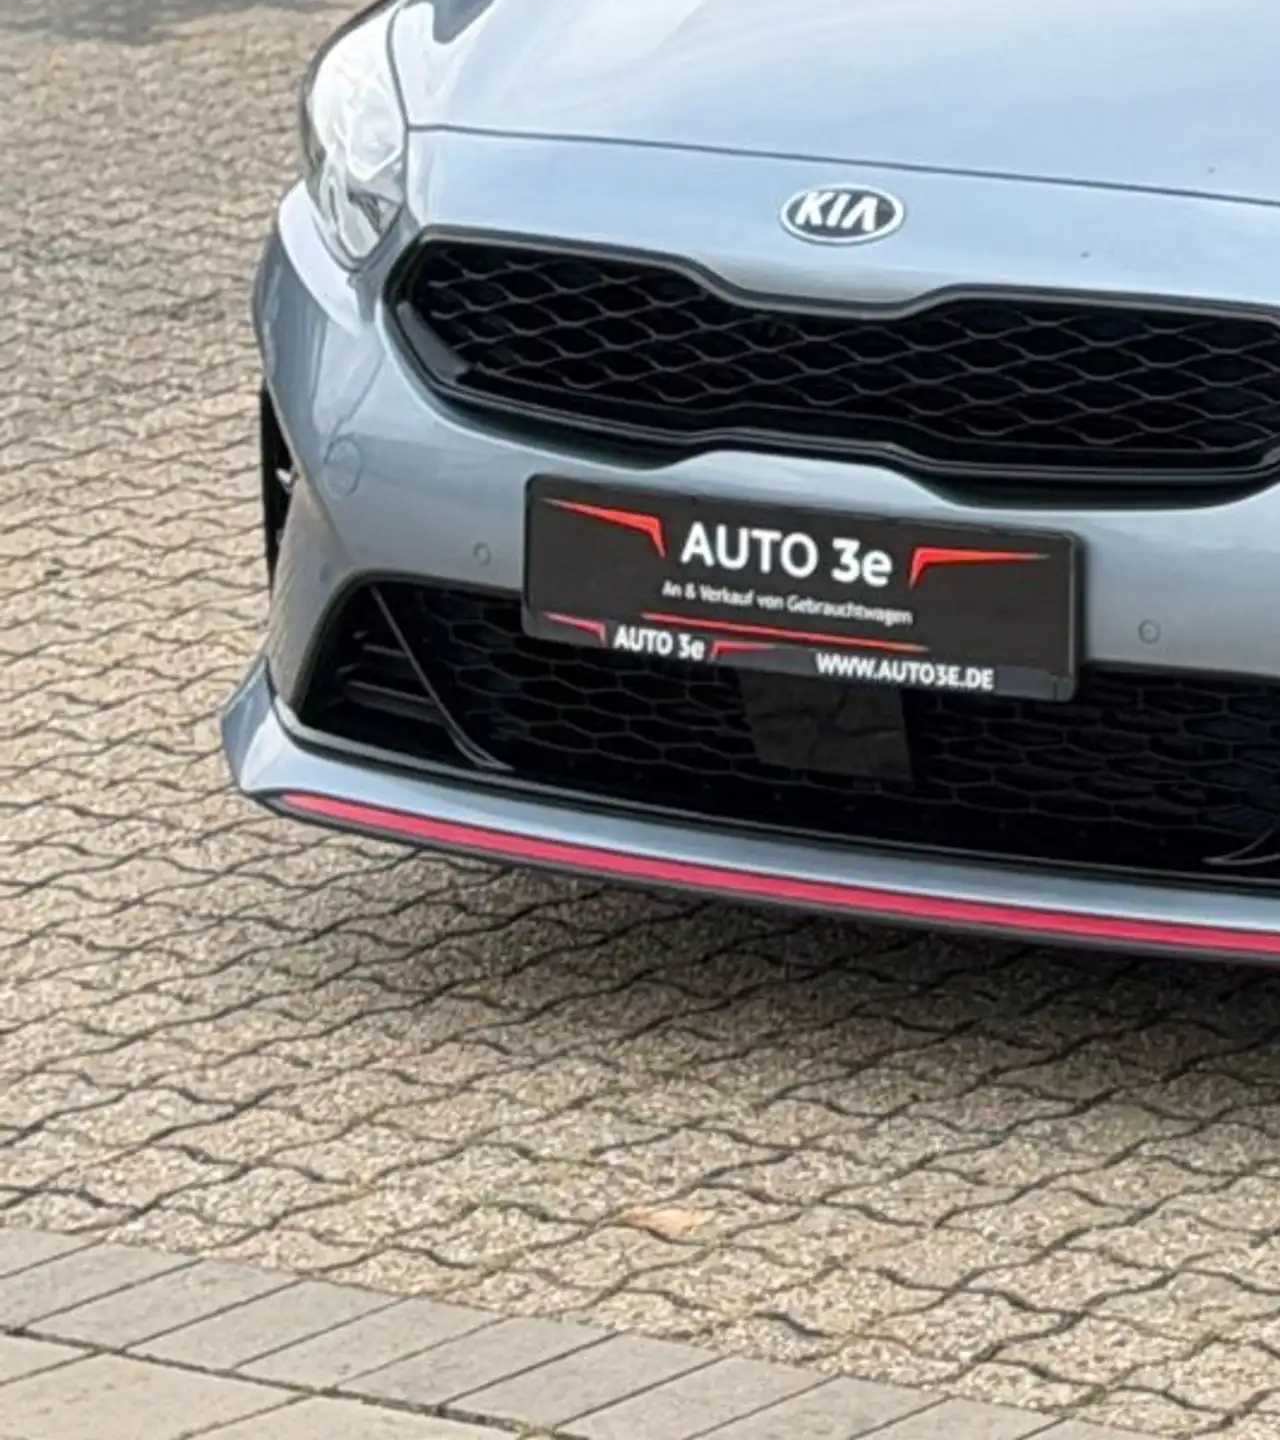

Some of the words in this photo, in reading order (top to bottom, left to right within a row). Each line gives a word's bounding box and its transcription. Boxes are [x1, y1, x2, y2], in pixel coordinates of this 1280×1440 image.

[795, 192, 878, 232] KIA
[681, 520, 818, 579] AUTO
[831, 537, 893, 588] 3e
[662, 579, 682, 597] An
[684, 582, 696, 599] &
[699, 583, 755, 608] Verkauf
[757, 595, 784, 611] von
[787, 594, 913, 627] Gebrauchtwagen
[614, 625, 673, 656] AUTO
[679, 634, 705, 661] 3e
[815, 652, 995, 691] WWW.AUTO3E.DE
